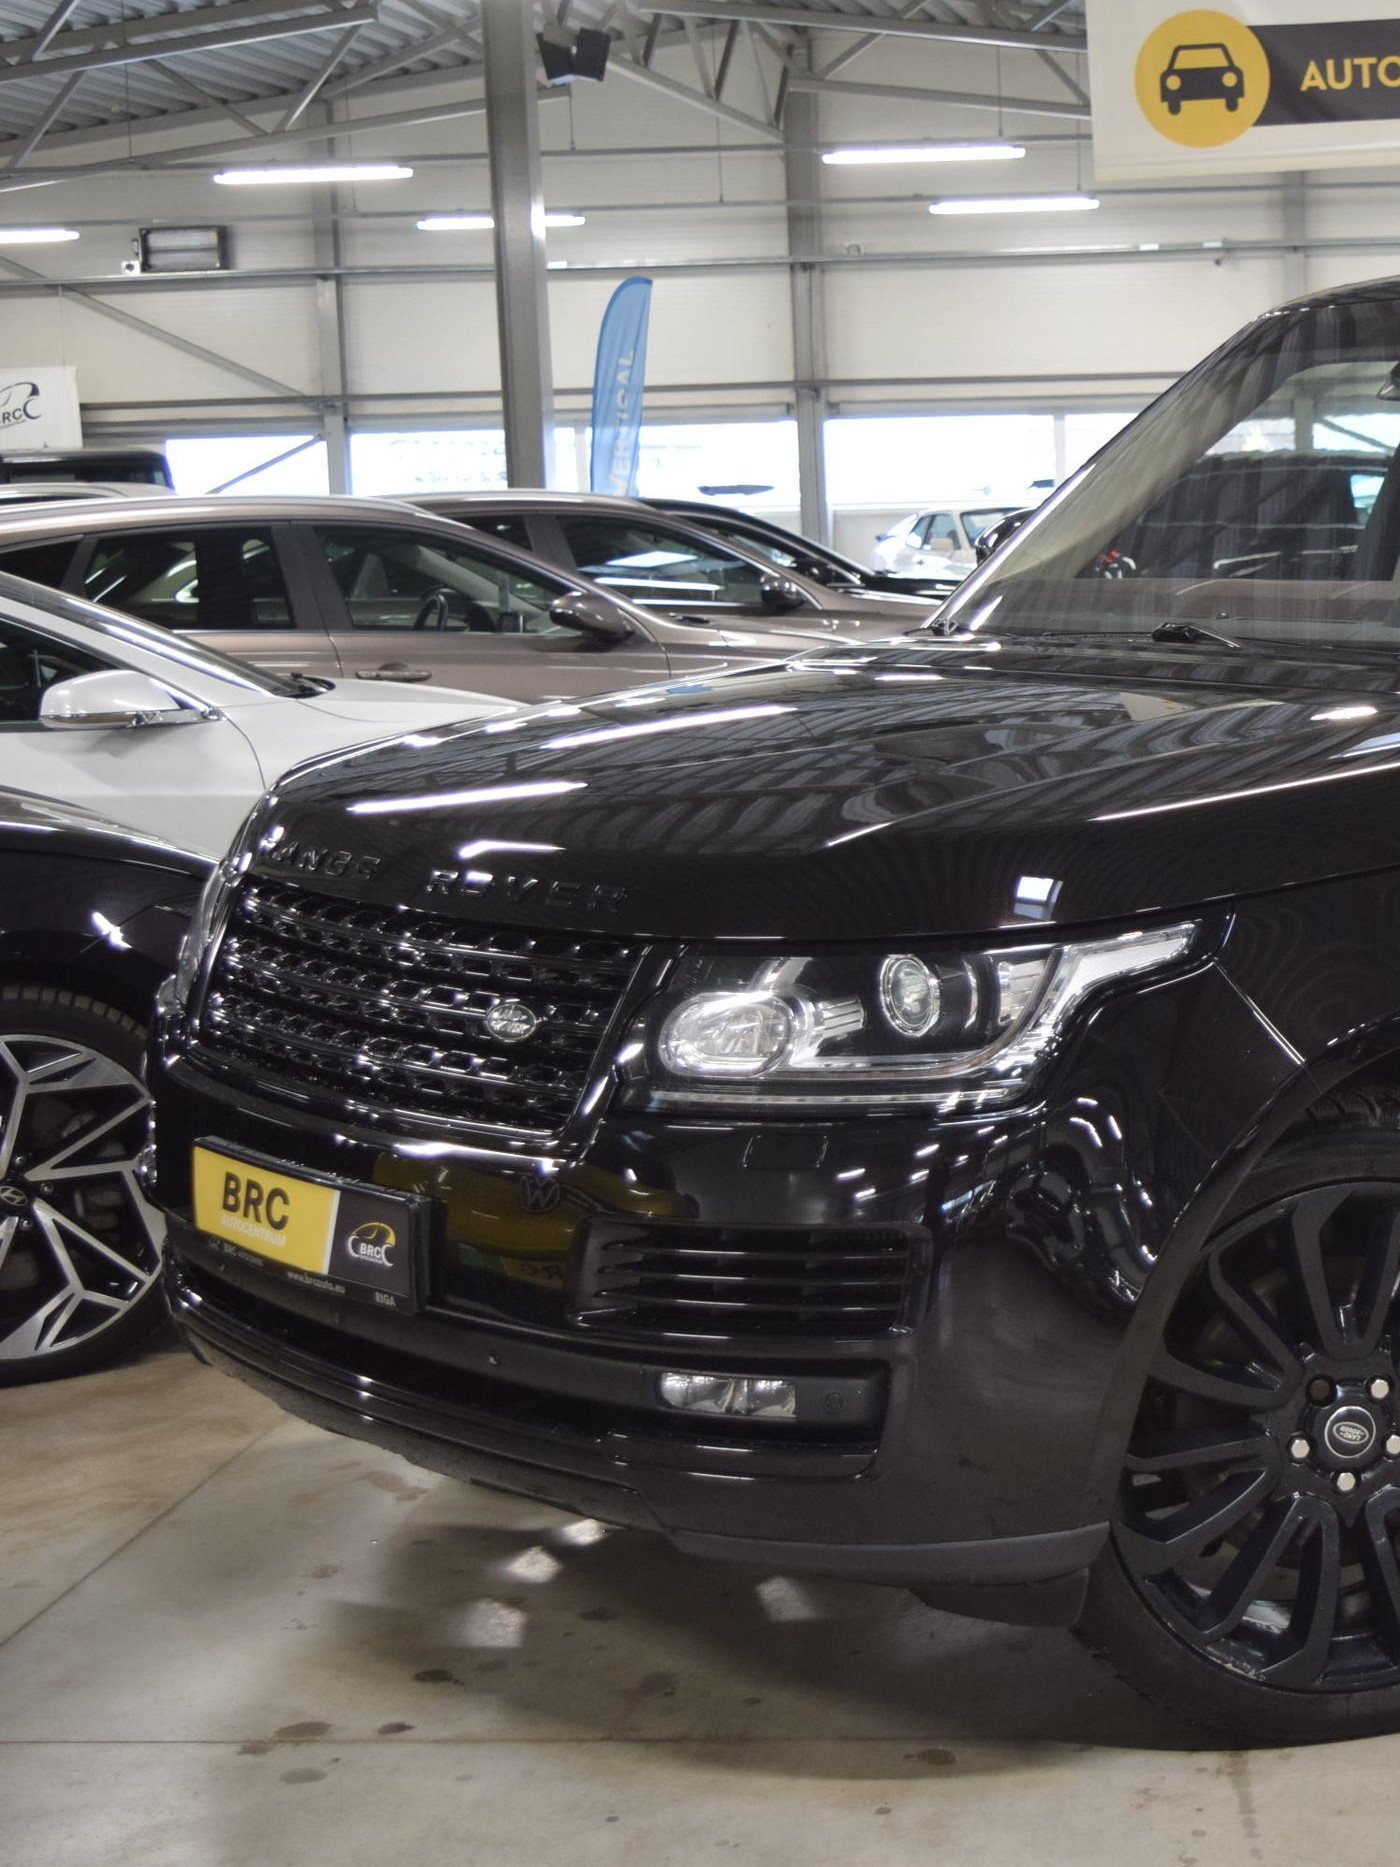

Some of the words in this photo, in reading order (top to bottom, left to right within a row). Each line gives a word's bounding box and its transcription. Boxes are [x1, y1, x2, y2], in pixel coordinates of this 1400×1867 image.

[0, 407, 23, 425] RC
[608, 348, 634, 498] VERTICAL
[426, 868, 630, 913] ROVER
[222, 1171, 290, 1231] BRC
[220, 1213, 288, 1248] AUTOCENTRUM
[359, 1242, 382, 1259] BRC
